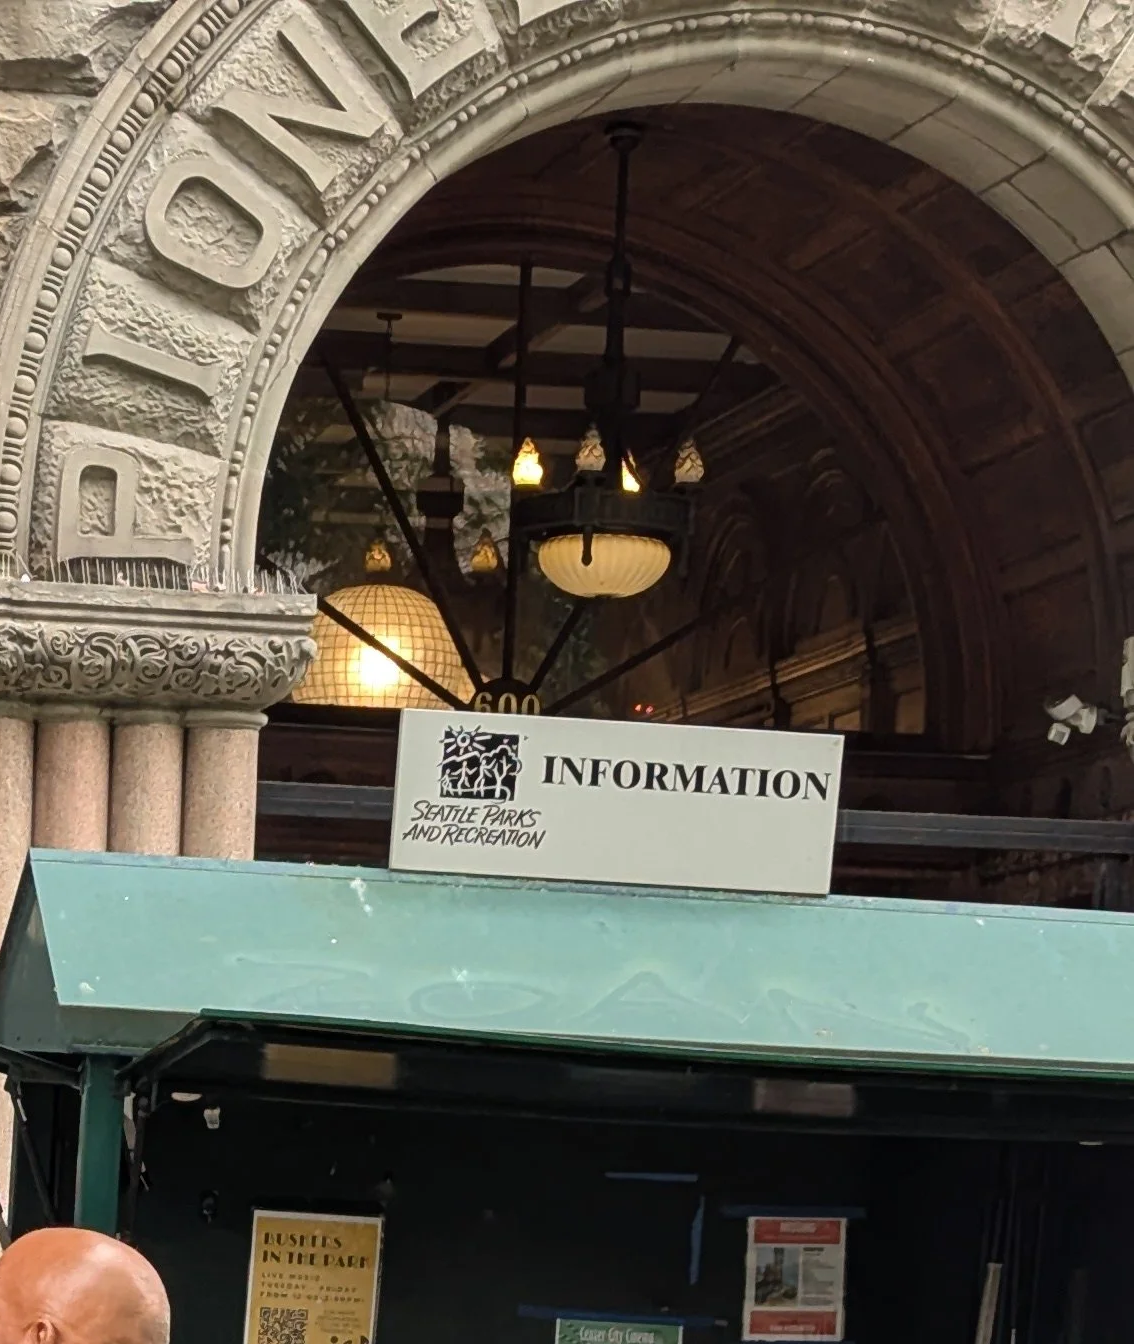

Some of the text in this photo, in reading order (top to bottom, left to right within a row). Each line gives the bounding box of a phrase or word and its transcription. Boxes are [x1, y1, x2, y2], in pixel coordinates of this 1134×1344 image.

[57, 0, 578, 565] PIONE
[541, 754, 832, 802] INFORMATION
[410, 799, 542, 828] SEATTLE PARKS
[402, 823, 546, 849] AND RECREATION
[264, 1232, 342, 1249] BUSKERS
[262, 1250, 372, 1269] IN THE PARK
